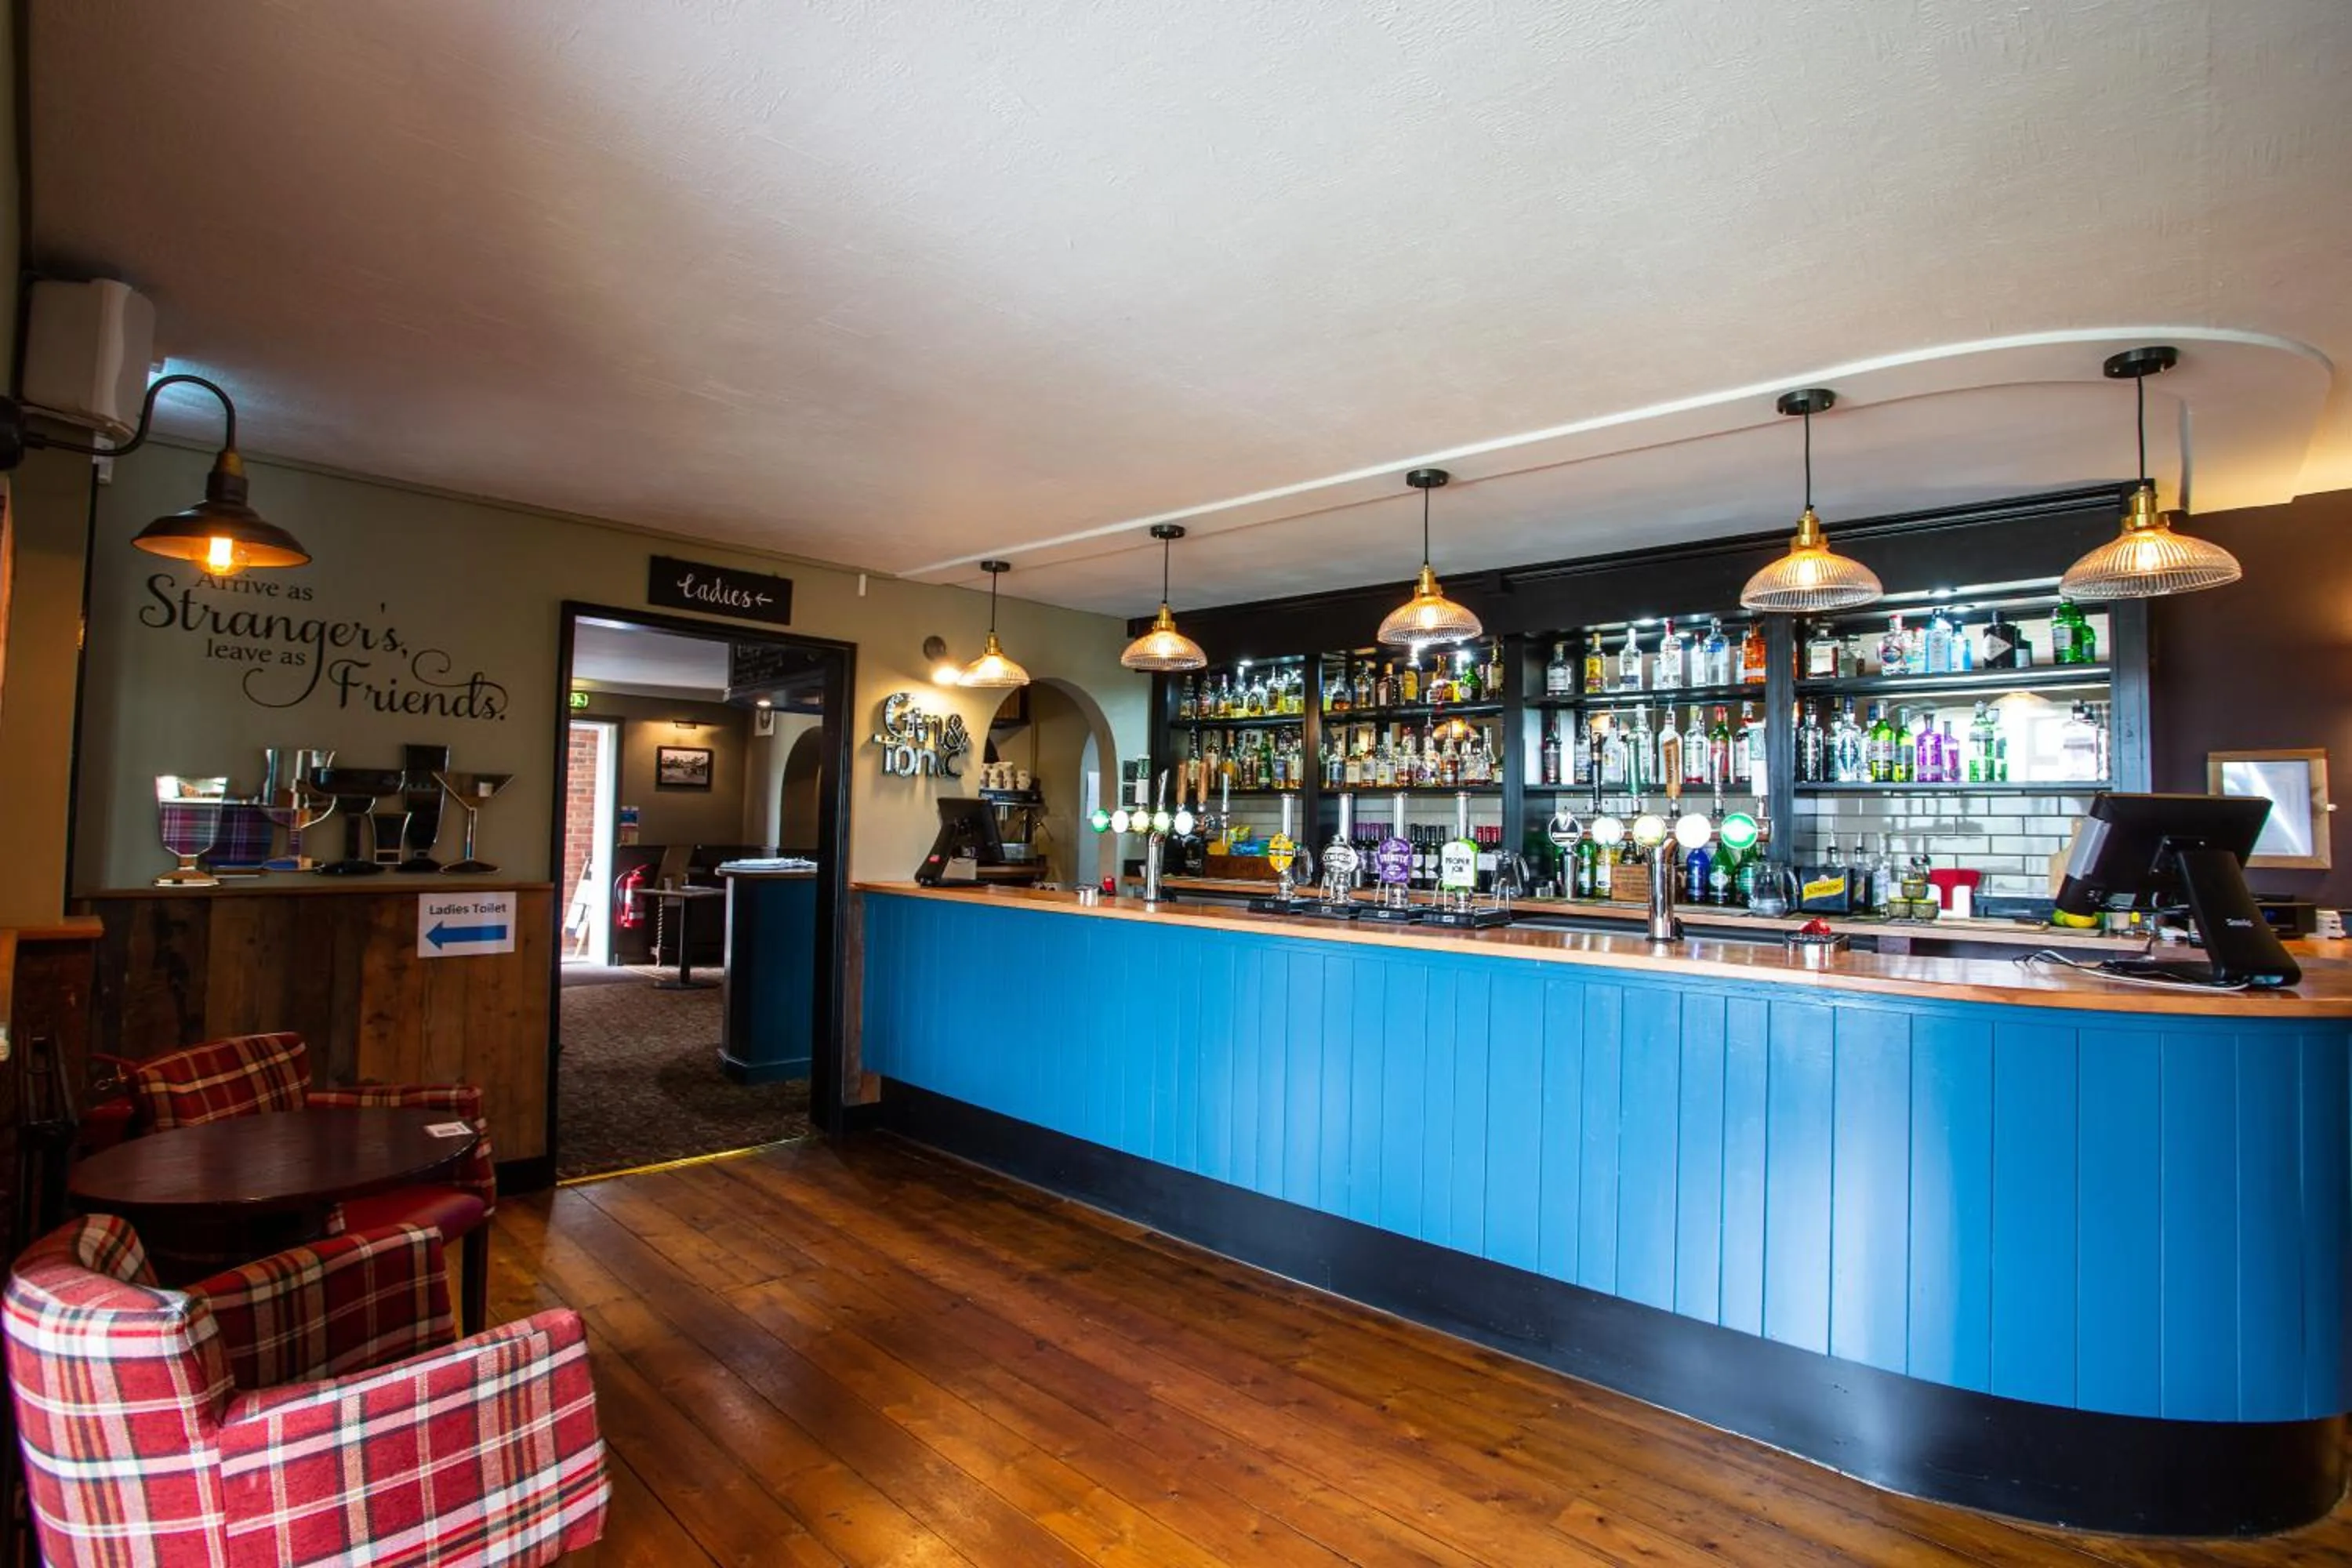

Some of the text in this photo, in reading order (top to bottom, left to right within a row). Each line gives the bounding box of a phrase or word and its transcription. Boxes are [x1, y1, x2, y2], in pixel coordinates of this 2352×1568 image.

[195, 572, 314, 601] Arrive as
[677, 573, 753, 608] Ladies
[206, 638, 307, 666] leave as
[328, 648, 508, 721] Friends.
[884, 692, 942, 745] Gin
[429, 902, 507, 916] Ladies Toilet
